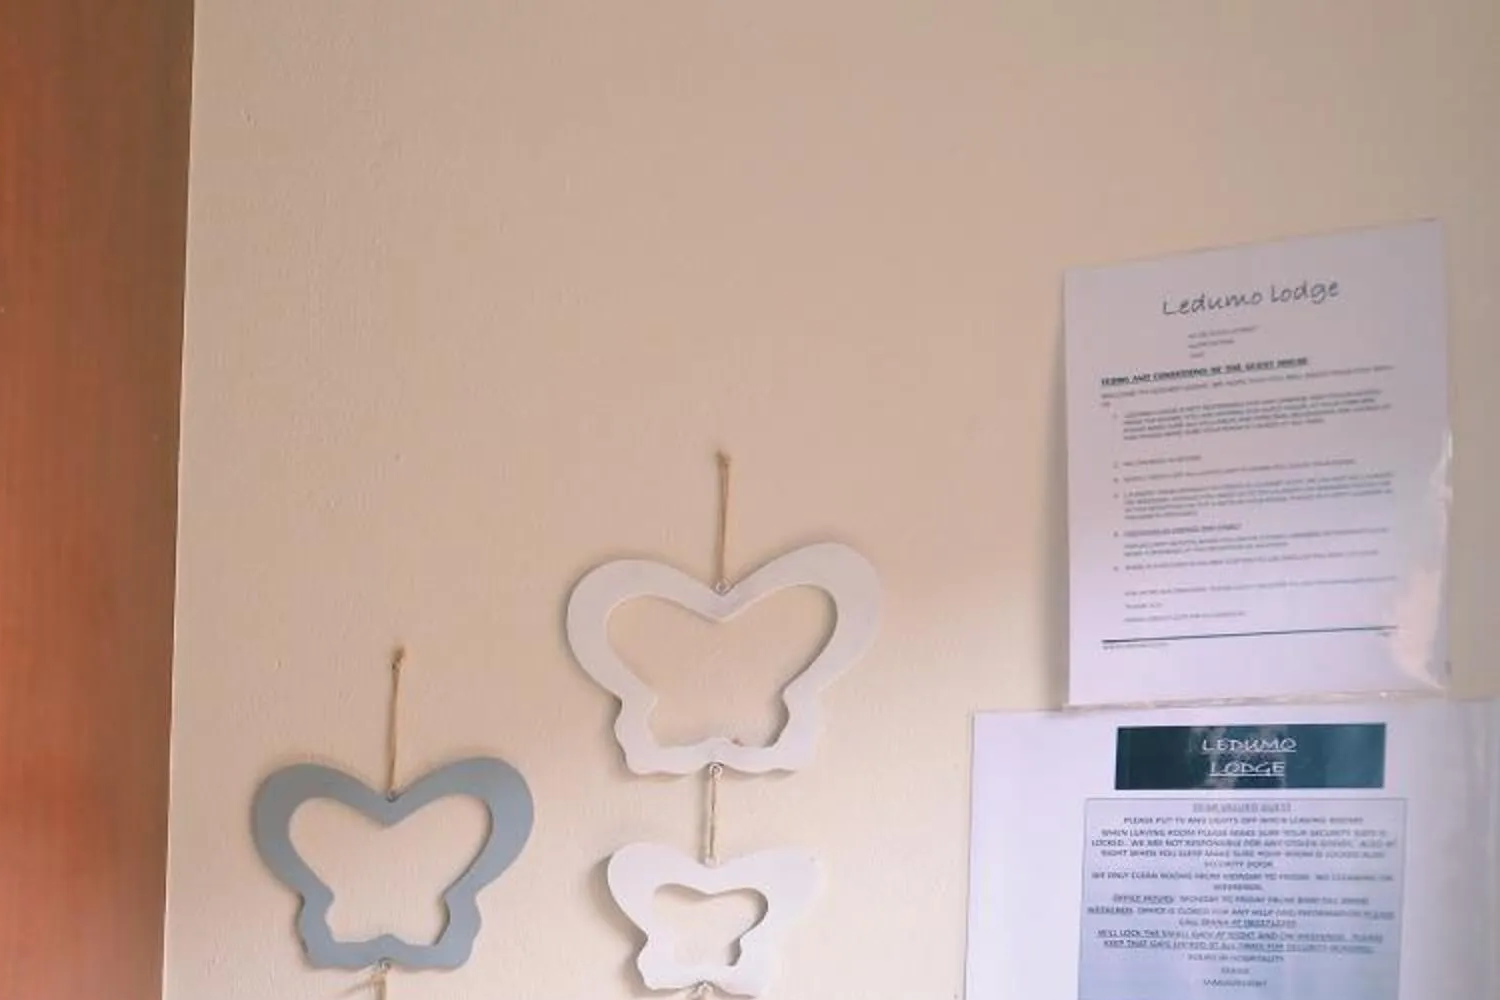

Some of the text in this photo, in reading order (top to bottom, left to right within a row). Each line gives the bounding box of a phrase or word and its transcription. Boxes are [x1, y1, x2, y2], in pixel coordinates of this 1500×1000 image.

[1162, 292, 1263, 315] Ledumo
[1202, 738, 1297, 753] LEDUMO
[1210, 761, 1285, 776] LODGE
